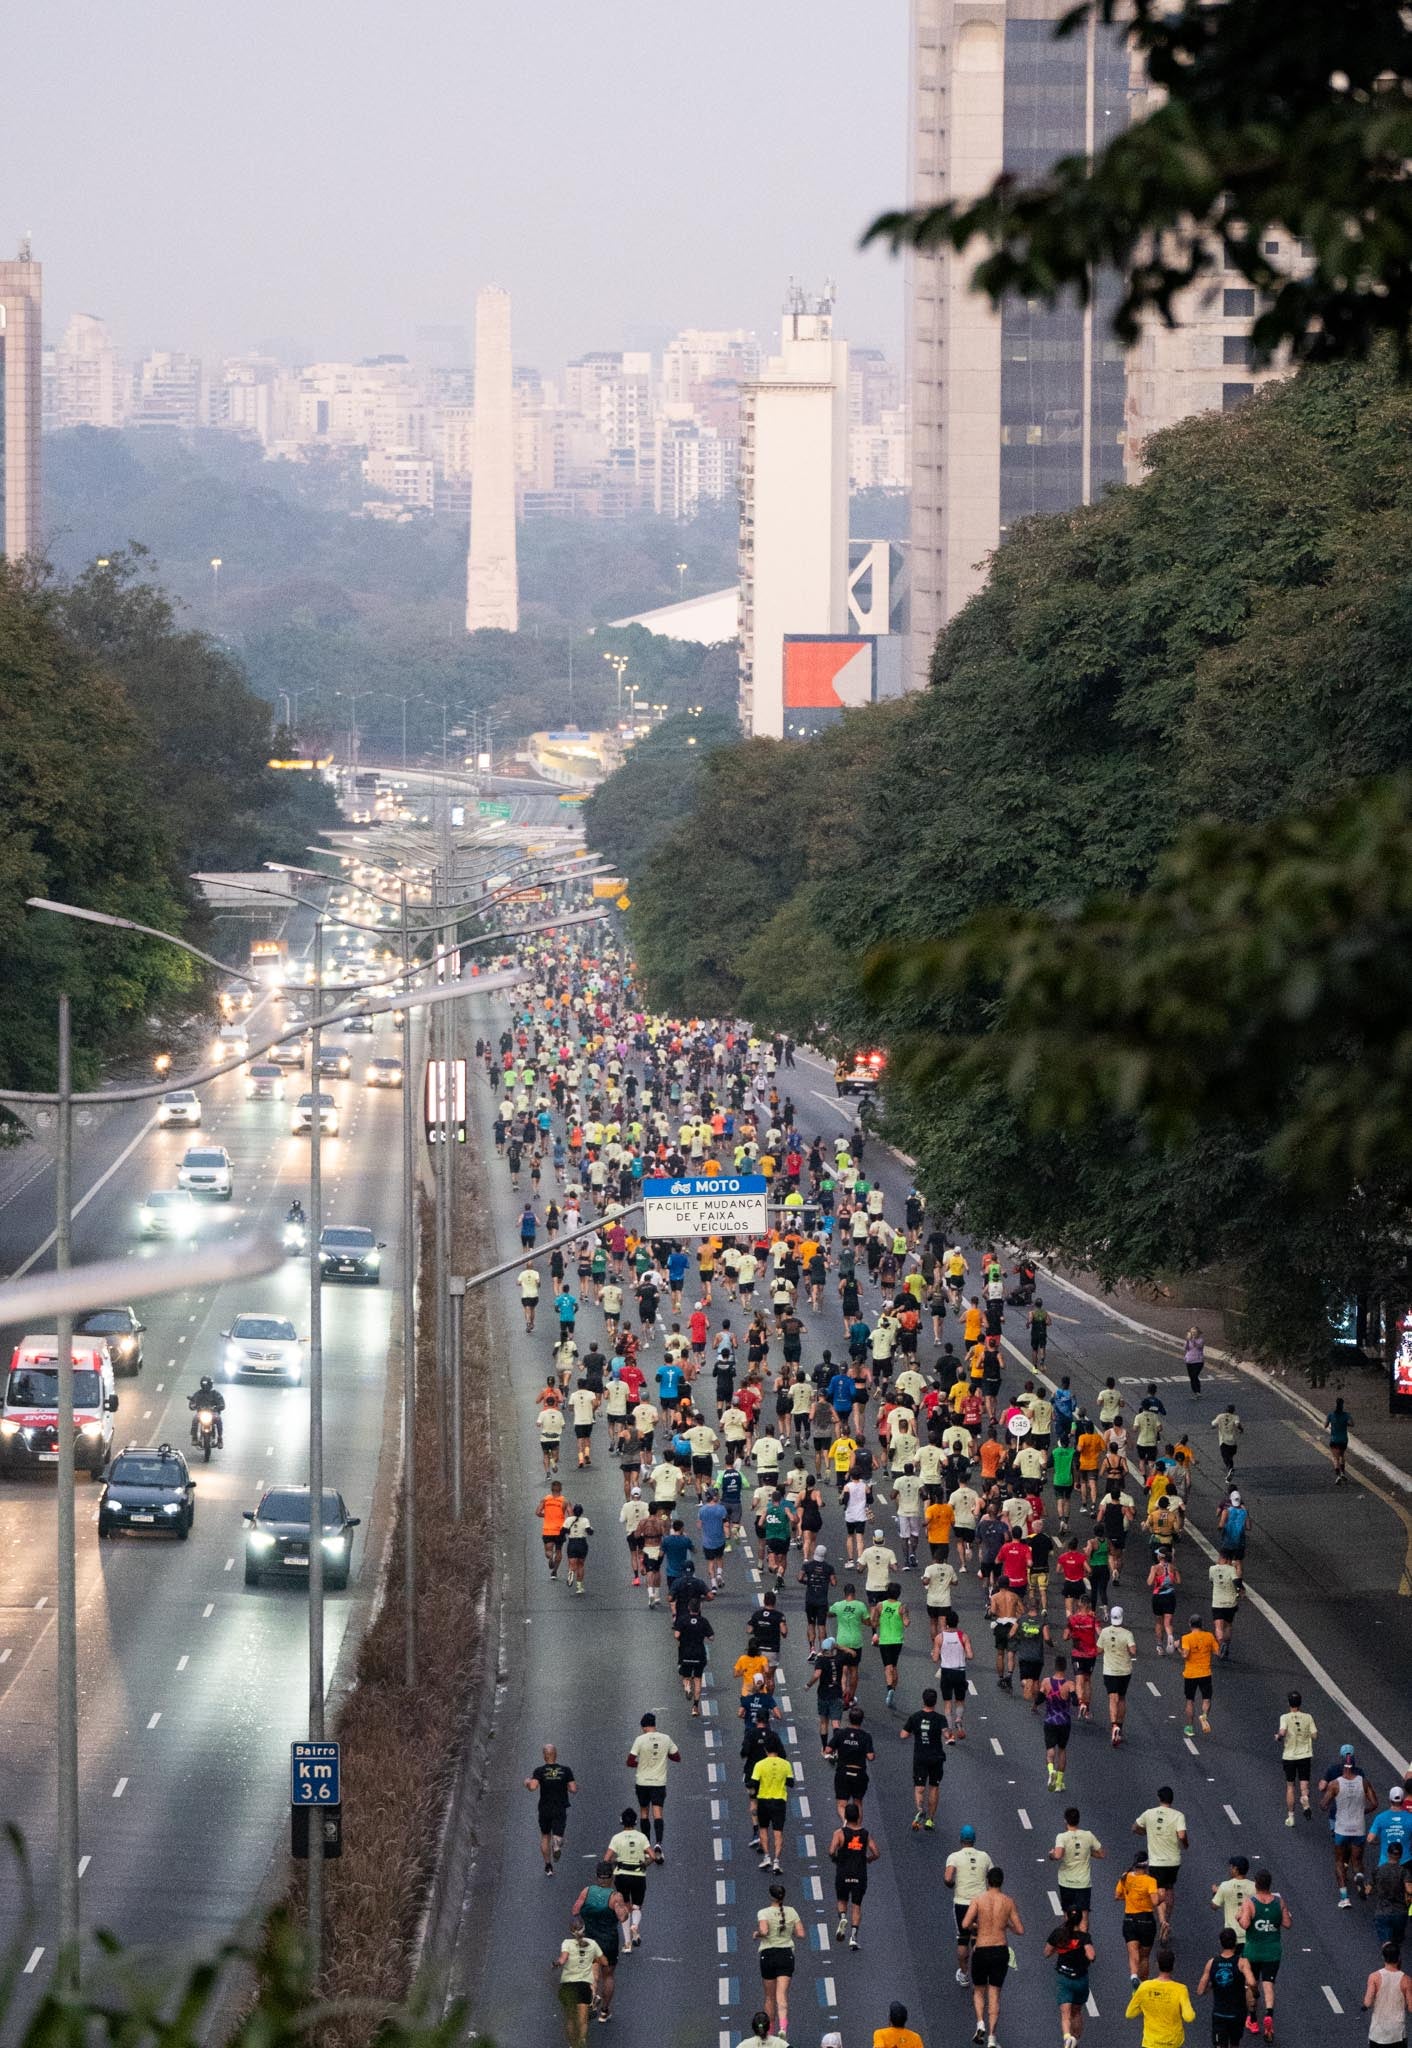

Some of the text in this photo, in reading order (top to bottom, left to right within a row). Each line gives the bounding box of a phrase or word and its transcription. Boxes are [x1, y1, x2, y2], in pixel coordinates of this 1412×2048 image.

[695, 1179, 740, 1193] MOTO
[649, 1199, 763, 1211] FACILITE MUDANÇA
[676, 1212, 735, 1221] DE FAIXA
[296, 1746, 336, 1756] Bairro
[299, 1762, 332, 1778] km
[301, 1783, 331, 1801] 3,6
